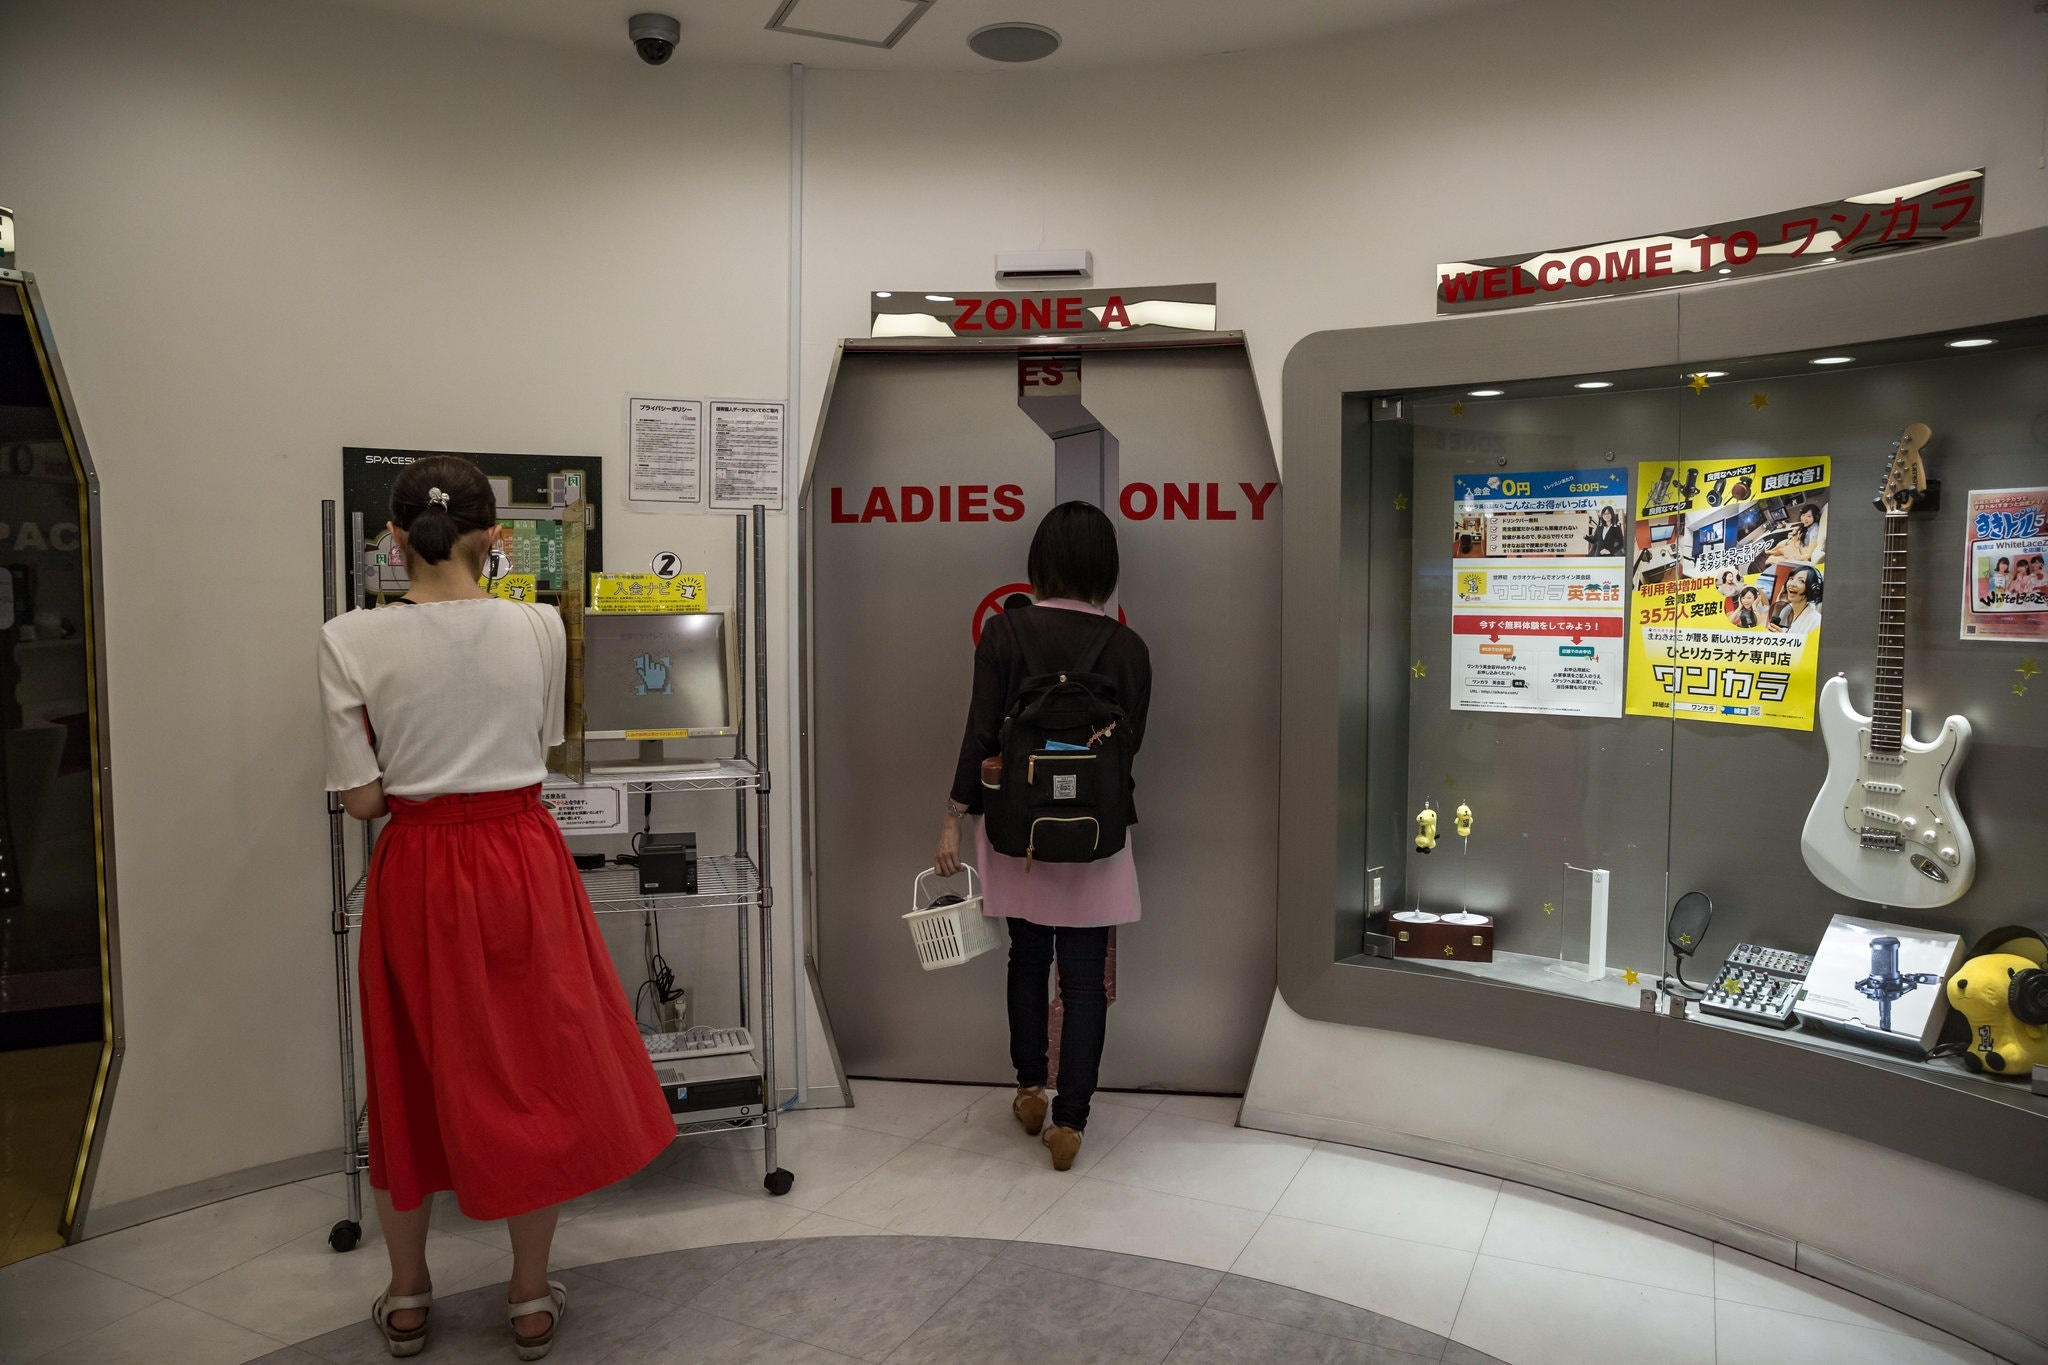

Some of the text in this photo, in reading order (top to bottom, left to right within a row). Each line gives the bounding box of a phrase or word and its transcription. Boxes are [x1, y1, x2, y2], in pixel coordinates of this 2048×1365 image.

[1440, 182, 1978, 304] WELCOME TO ワンカラ
[953, 296, 1132, 331] ZONE A
[639, 404, 693, 412] プライバシーポリシー
[1706, 466, 1754, 481] 良質なヘッドホン
[1465, 487, 1491, 497] 入会金
[1502, 479, 1531, 496] 0円
[831, 482, 1278, 524] LADIES ONLY
[1648, 502, 1687, 516] 良質なマイク
[1699, 539, 1774, 562] まるでレコーディング
[658, 554, 676, 576] 2
[1641, 576, 1715, 598] 利用者増加中
[1664, 593, 1696, 607] 会員数
[1711, 633, 1802, 648] 新しいカラオケのスタイル
[1666, 645, 1792, 667] ひとりカラオケ専門店
[1652, 664, 1791, 702] ワンカラ
[1691, 704, 1715, 712] ワンカラ
